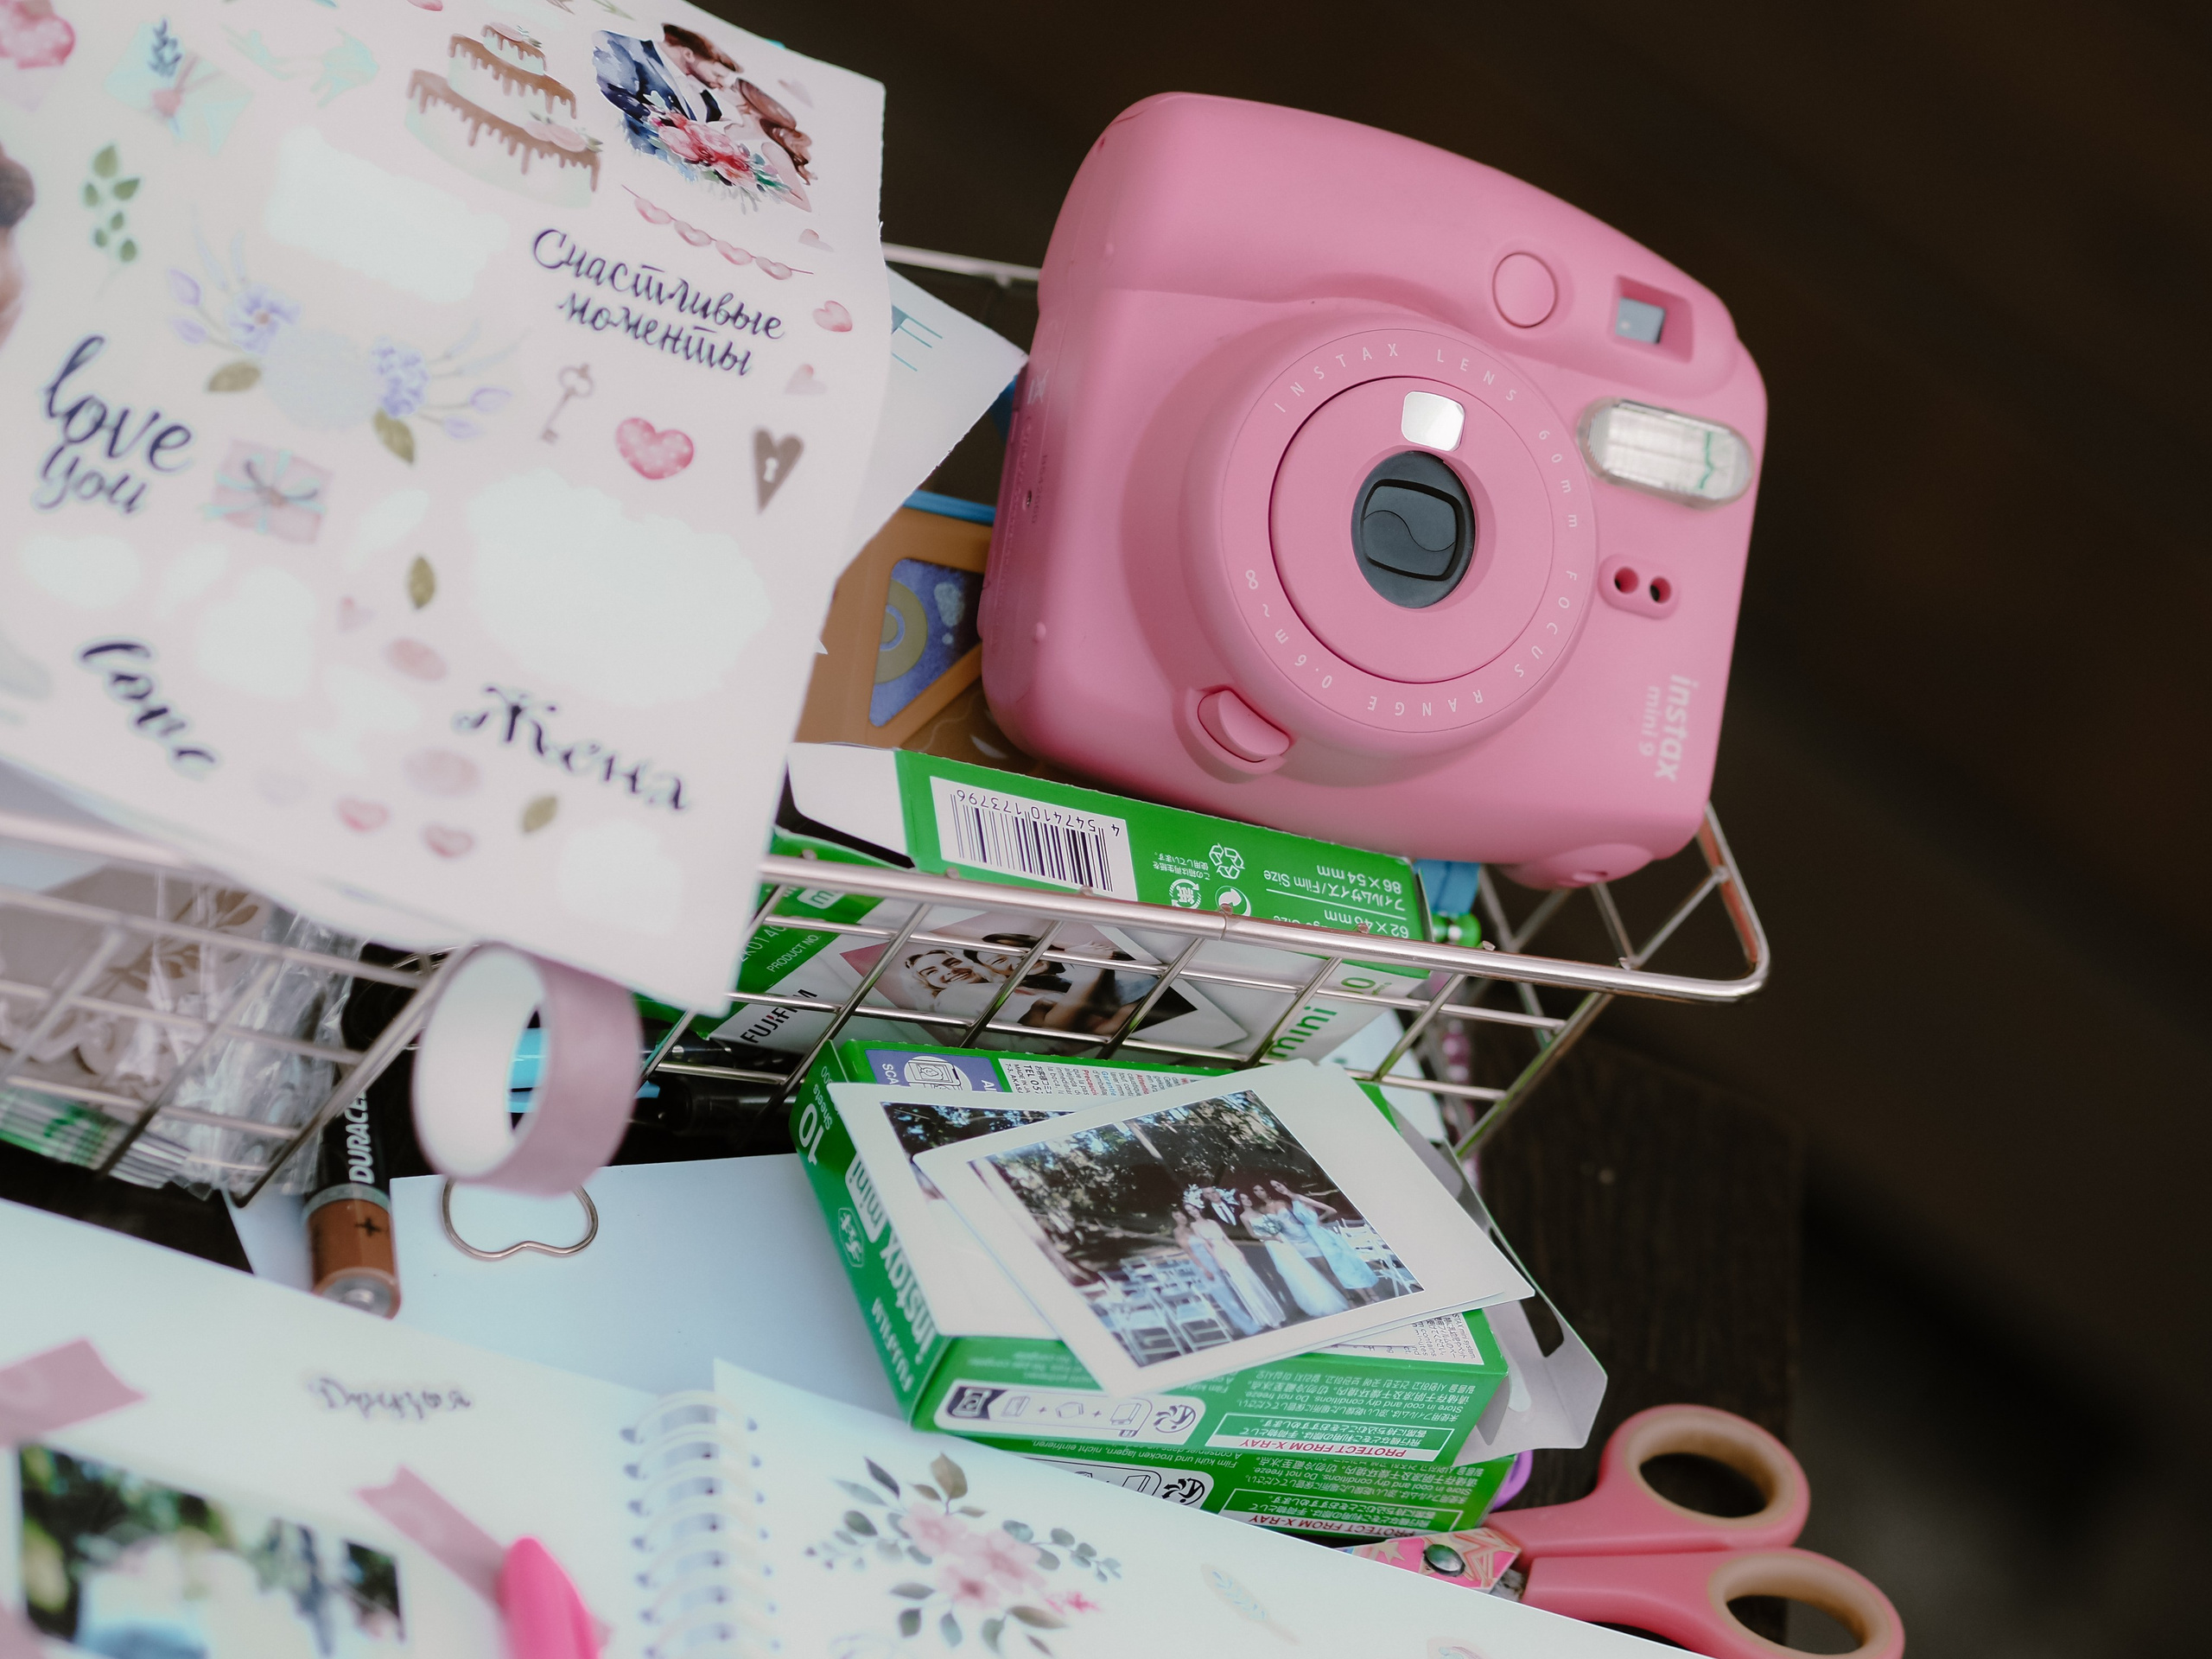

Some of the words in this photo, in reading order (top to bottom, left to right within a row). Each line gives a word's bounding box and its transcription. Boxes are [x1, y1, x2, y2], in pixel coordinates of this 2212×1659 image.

[531, 228, 785, 341] Счастливые
[556, 292, 753, 377] моменты
[1274, 343, 1398, 412] INSTAX
[1436, 348, 1517, 402] LENS
[44, 334, 193, 471] love
[33, 444, 148, 514] you
[1514, 570, 1577, 677] FOCUS
[1367, 690, 1484, 717] RANGE
[1641, 685, 1662, 738] mini
[1654, 675, 1700, 782] instax
[454, 684, 689, 810] Жена
[1638, 741, 1655, 757] 9
[957, 789, 1022, 815] 173796
[1031, 806, 1096, 833] 547410
[1111, 823, 1120, 836] 4
[1154, 852, 1208, 870] 使用しています。
[1263, 869, 1290, 887] Size
[766, 943, 805, 973] PRODUCT
[1266, 1006, 1338, 1058] mini
[1014, 1064, 1025, 1079] MADE
[1023, 1065, 1035, 1077] TEL
[813, 1084, 833, 1130] Sheets
[798, 1103, 824, 1166] 10
[849, 1160, 884, 1226] mini
[879, 1230, 938, 1365] instax
[1293, 1394, 1309, 1402] Do
[1365, 1398, 1382, 1407] dry
[1382, 1400, 1402, 1408] and
[1403, 1402, 1424, 1410] cool
[1437, 1404, 1463, 1413] Store
[1077, 1444, 1102, 1453] nicht
[1238, 1438, 1287, 1448] X-RAY
[1286, 1442, 1334, 1452] FROM
[1138, 1450, 1173, 1461] trocken
[1335, 1445, 1406, 1457] PROTECT
[1174, 1454, 1193, 1463] und
[1195, 1456, 1215, 1466] kühl
[1217, 1458, 1237, 1468] Film
[1252, 1466, 1283, 1477] freeze.
[1304, 1471, 1318, 1480] Do
[1322, 1473, 1372, 1484] conditions.
[1374, 1478, 1389, 1486] dry
[1391, 1480, 1410, 1490] and
[1412, 1483, 1433, 1491] cool
[1446, 1485, 1471, 1495] Store
[1248, 1514, 1296, 1527] X-RAY
[1299, 1519, 1342, 1531] FROM
